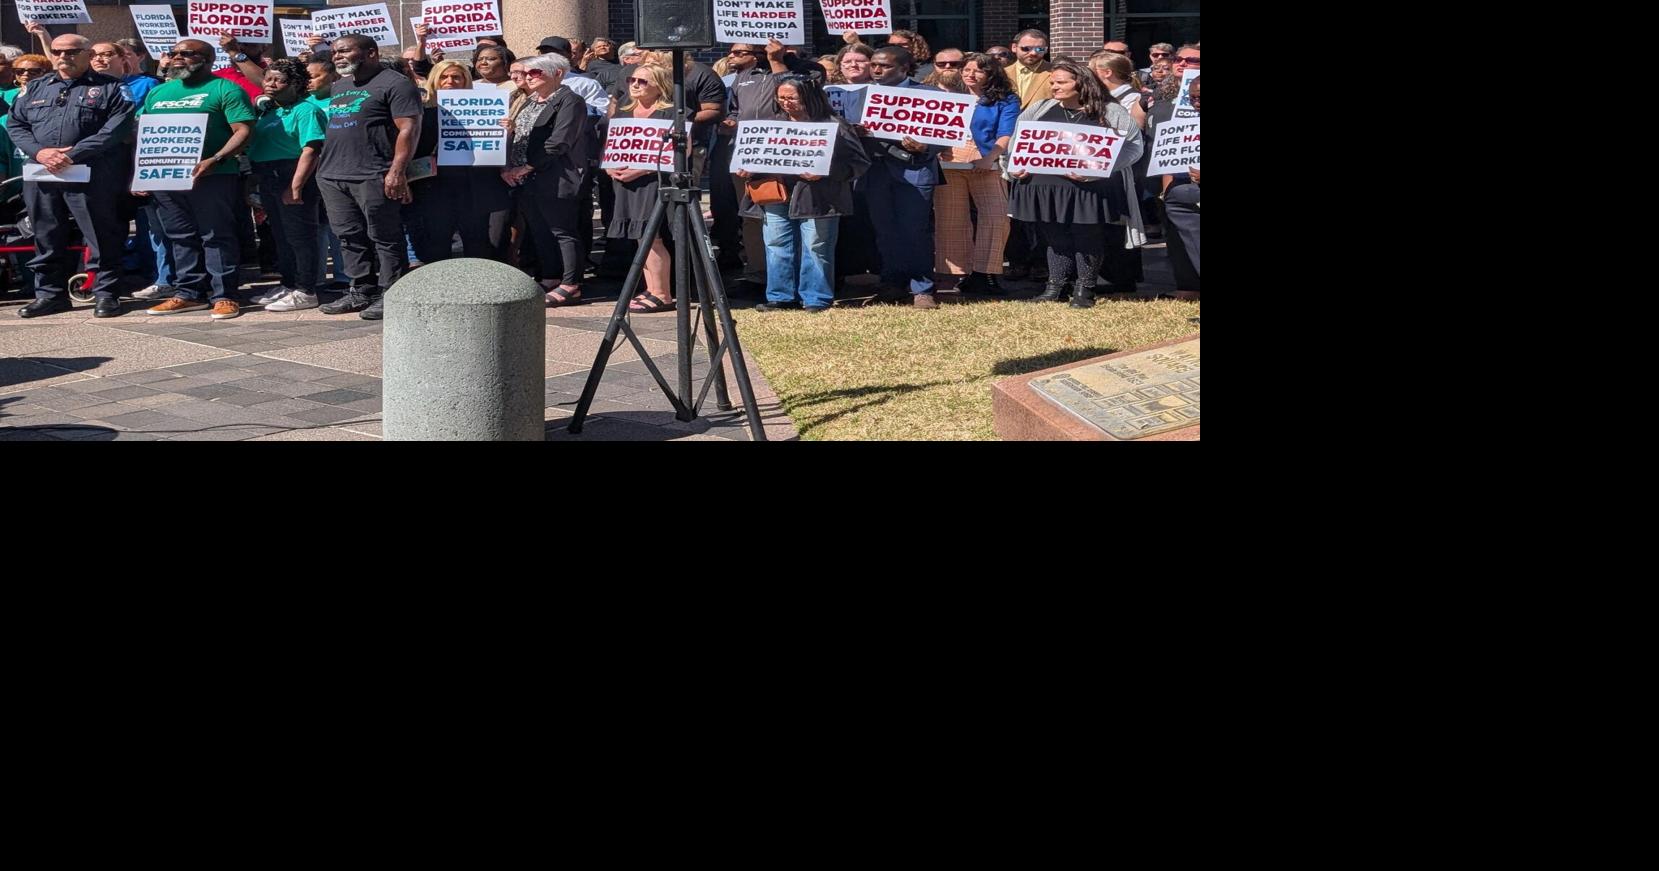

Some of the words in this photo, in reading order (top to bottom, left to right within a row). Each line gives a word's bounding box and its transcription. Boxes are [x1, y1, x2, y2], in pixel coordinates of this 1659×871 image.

[190, 2, 268, 15] SUPPORT
[424, 2, 493, 15] SUPPORT
[824, 8, 887, 19] FLORIDA
[23, 12, 79, 20] WORKERS!
[190, 13, 269, 27] FLORIDA
[315, 13, 344, 23] DON'T
[348, 8, 382, 19] MAKE
[424, 12, 497, 25] FLORIDA
[717, 10, 738, 18] LIFE
[741, 11, 797, 19] HARDER
[315, 22, 336, 31] LIFE
[338, 17, 386, 28] HARDER
[427, 23, 499, 35] WORKERS!
[718, 19, 738, 27] FOR
[741, 21, 797, 29] FLORIDA
[828, 20, 889, 30] WORKERS!
[190, 26, 269, 38] WORKERS!
[340, 25, 389, 37] FLORIDA
[724, 30, 789, 39] WORKERS!
[424, 38, 475, 49] ORKERS!
[441, 98, 505, 106] FLORIDA
[870, 94, 969, 114] SUPPORT
[441, 108, 506, 117] WORKERS
[866, 106, 965, 128] FLORIDA
[441, 118, 474, 127] KEEP
[142, 126, 202, 135] FLORIDA
[609, 126, 669, 138] SUPPOR
[742, 126, 783, 134] DON'T
[786, 128, 829, 136] MAKE
[864, 120, 964, 141] WORKERS!
[1160, 124, 1198, 136] DON'T
[141, 137, 202, 145] WORKERS
[443, 140, 500, 151] SAFE!
[740, 137, 765, 145] LIFE
[767, 137, 829, 147] HARDER
[1157, 137, 1180, 147] LIFE
[140, 146, 169, 154] KEEP
[170, 146, 200, 154] OUR
[737, 147, 760, 156] FOR
[763, 148, 825, 157] FLORIDA
[1015, 142, 1112, 159] FLORIDA
[1154, 148, 1177, 158] FOR
[139, 158, 197, 166] COMMUNITIES
[741, 158, 815, 168] WORKERS!
[1013, 156, 1110, 171] WORKERS!
[139, 168, 193, 180] SAFE!
